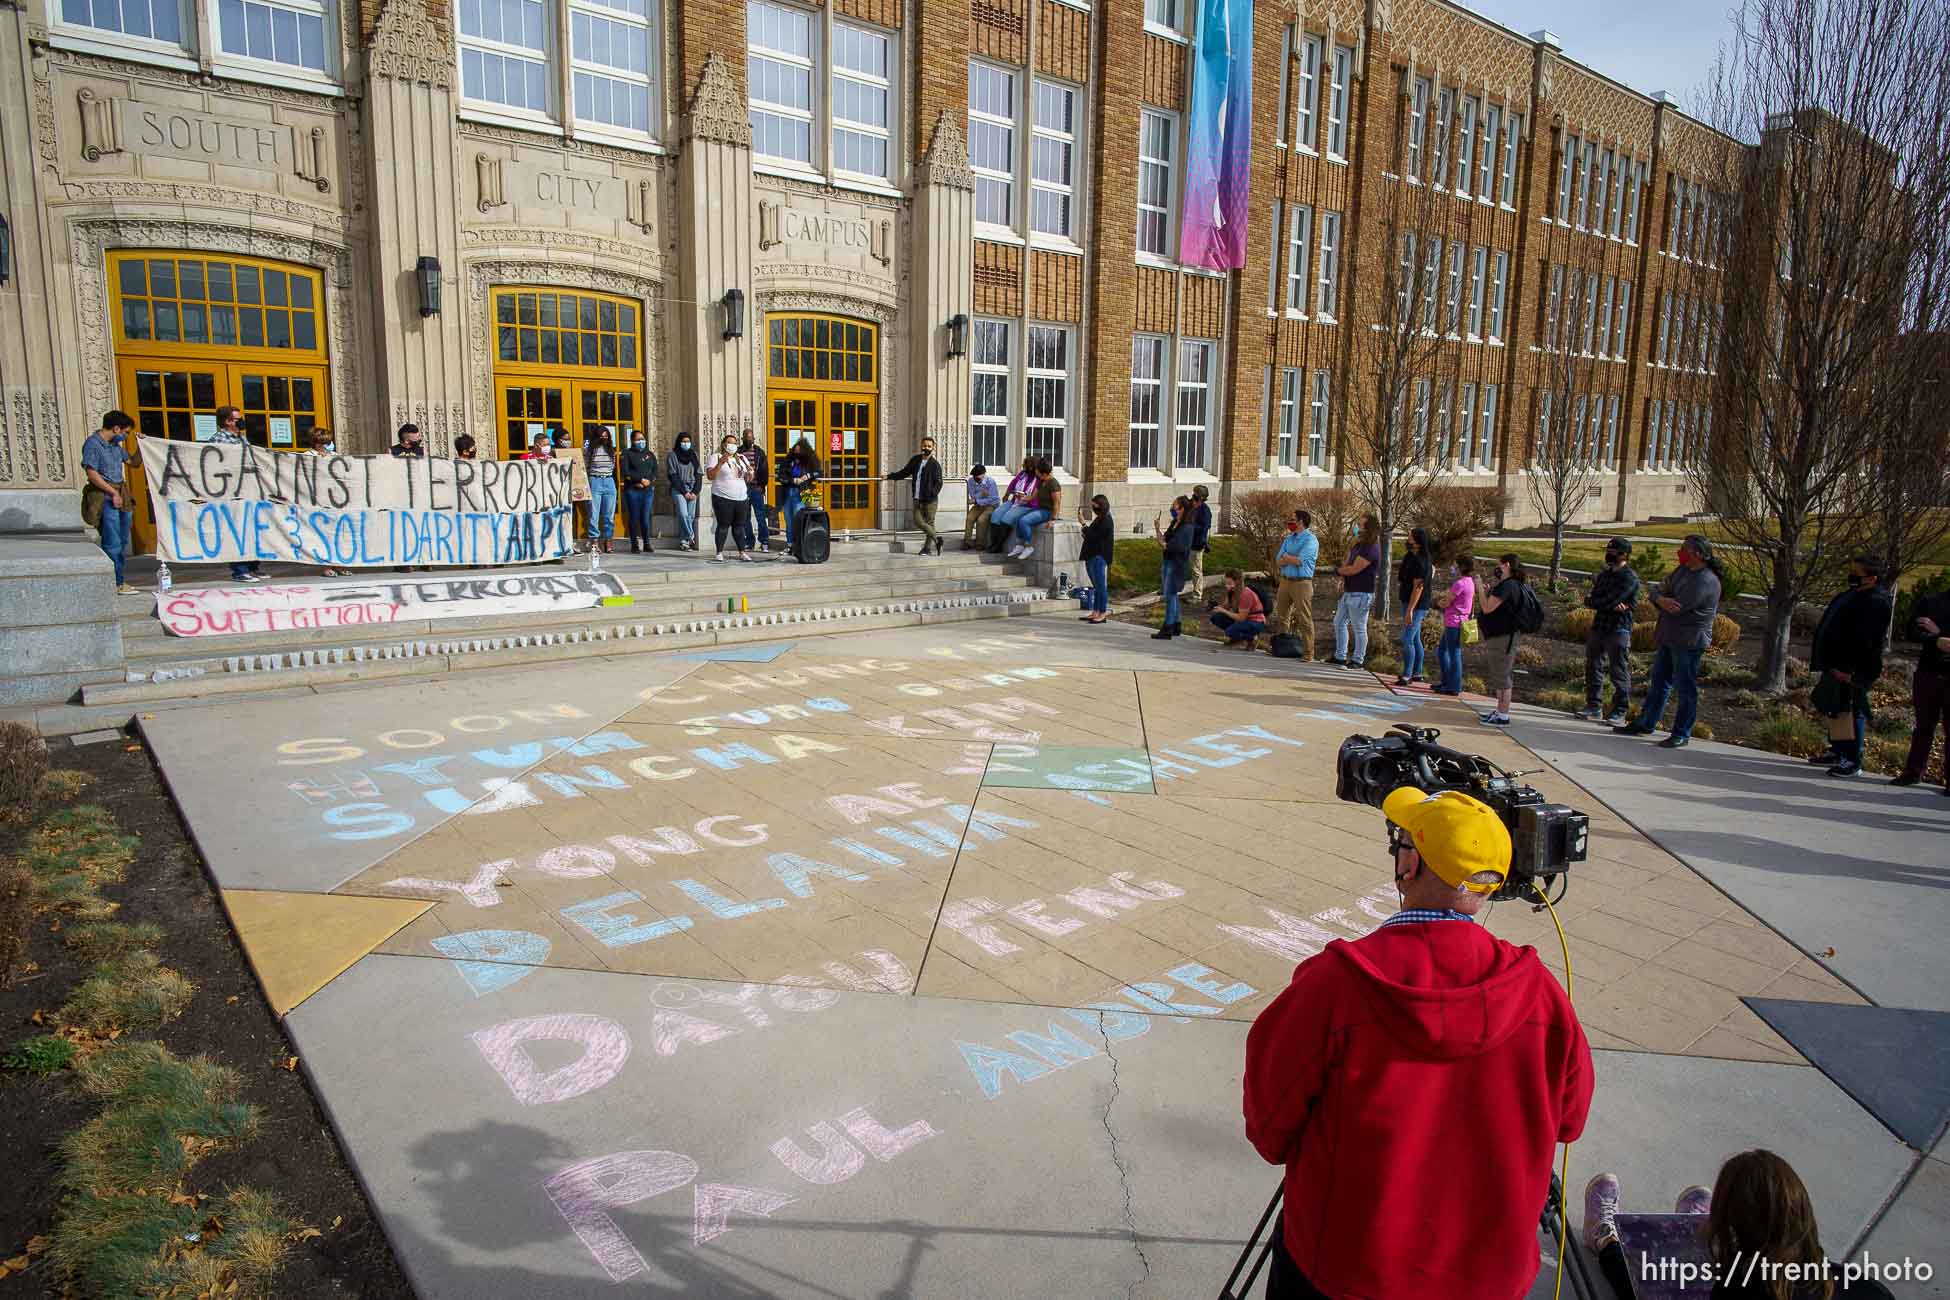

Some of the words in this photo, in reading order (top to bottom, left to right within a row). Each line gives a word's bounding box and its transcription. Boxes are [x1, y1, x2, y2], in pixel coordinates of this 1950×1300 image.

[140, 111, 280, 165] SOUTH
[535, 171, 602, 210] CITY
[784, 211, 871, 249] CAMPUS
[158, 441, 377, 509] AGAINST
[403, 454, 574, 513] TERRORISM
[168, 500, 278, 561] LOVE
[307, 510, 504, 565] SOLIDARITY
[276, 702, 592, 766] SOON
[382, 815, 770, 909] YONG
[826, 782, 951, 825] AE
[930, 870, 1187, 958] FENG
[543, 1103, 946, 1285] PAUL
[955, 960, 1260, 1100] ANDRE
